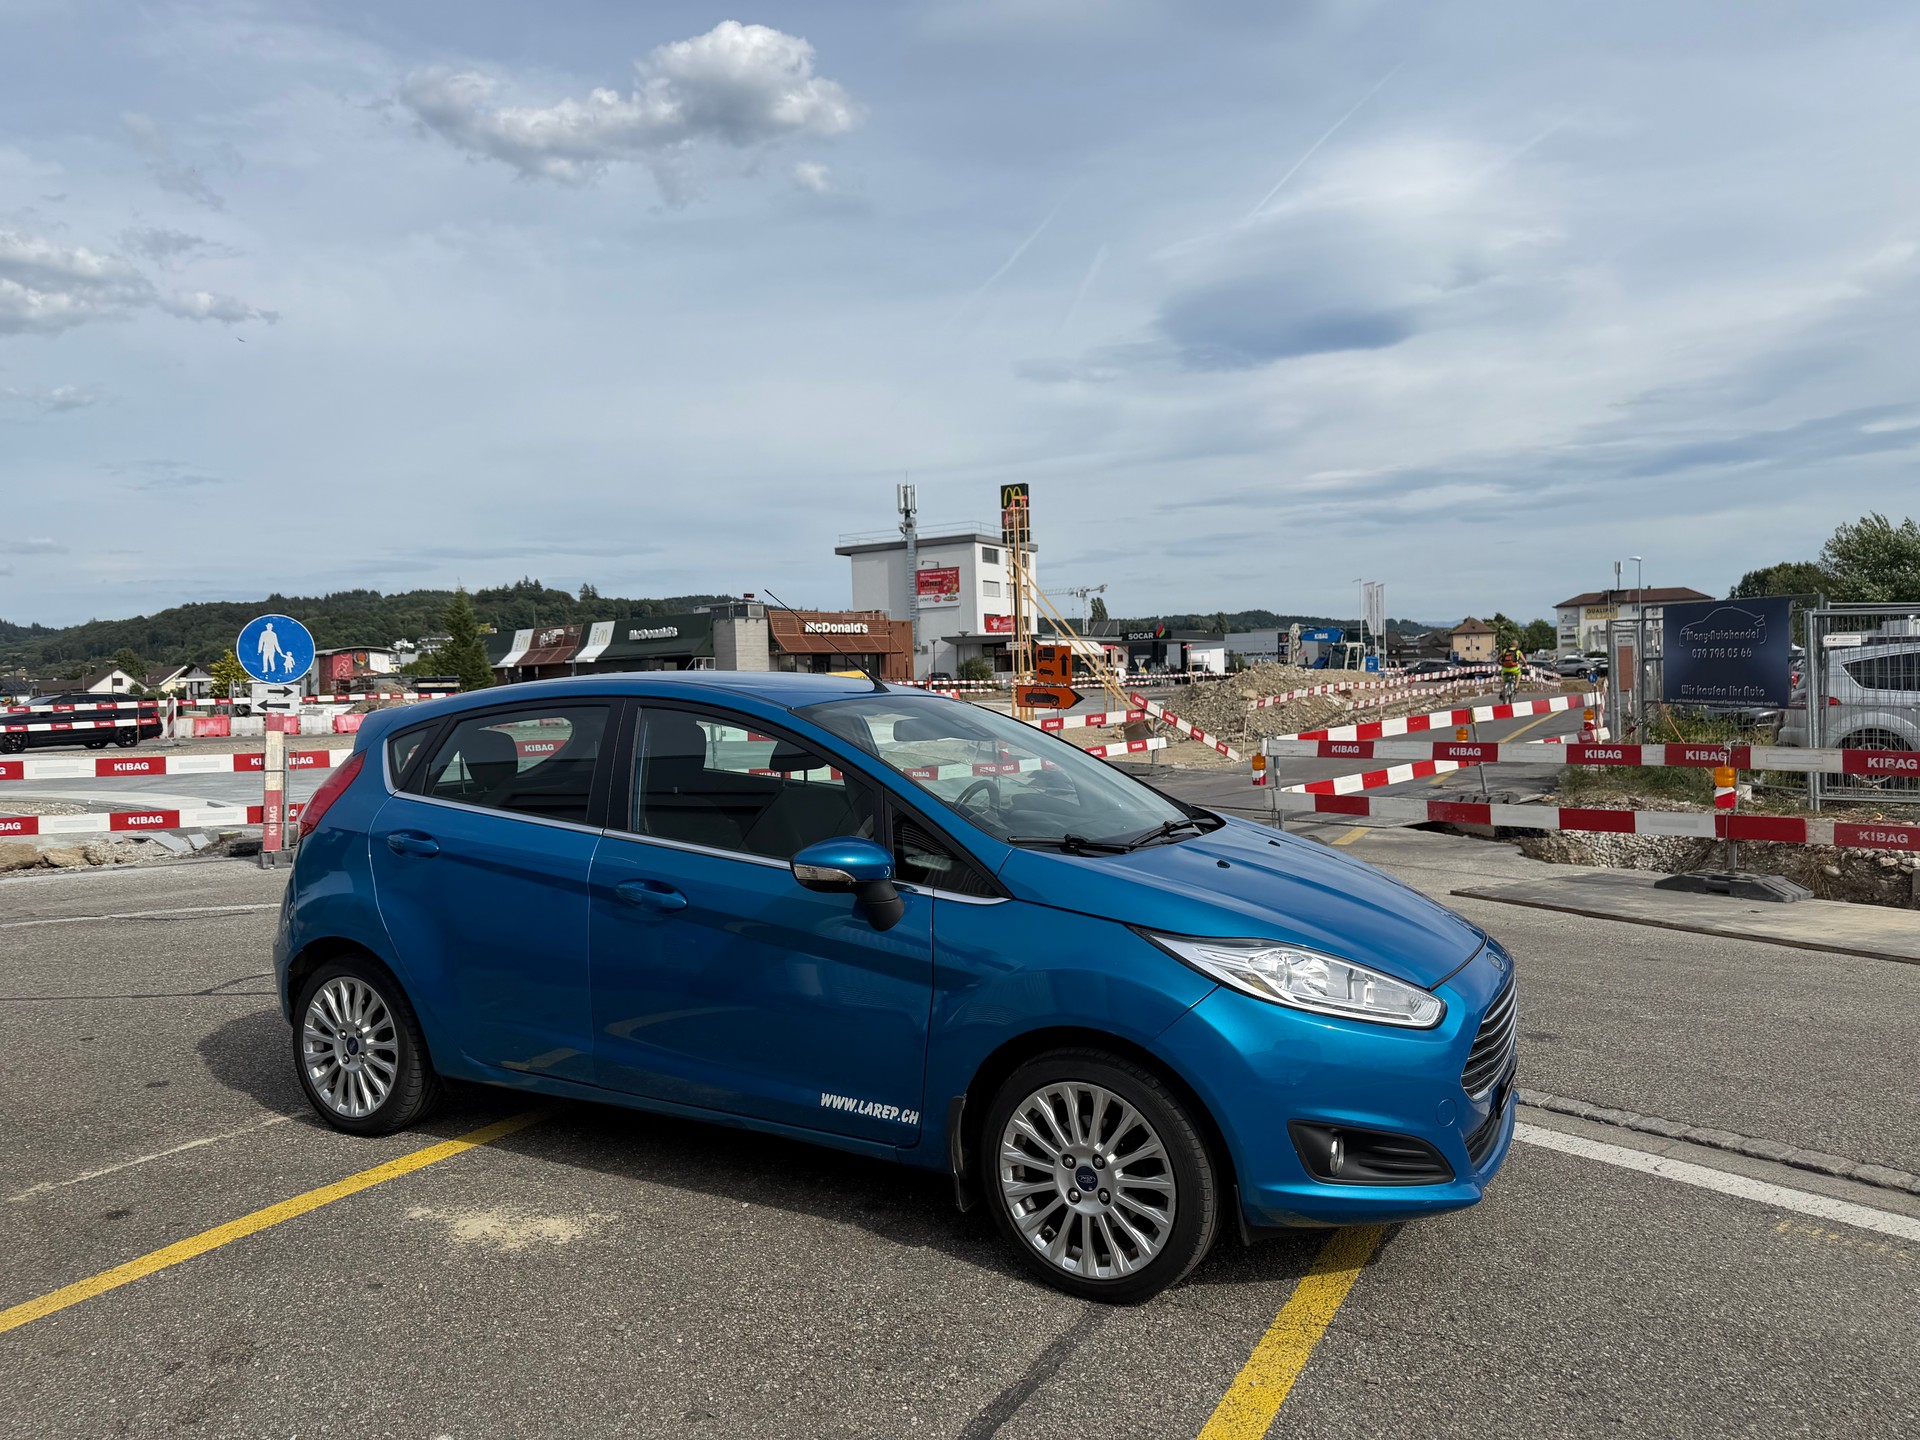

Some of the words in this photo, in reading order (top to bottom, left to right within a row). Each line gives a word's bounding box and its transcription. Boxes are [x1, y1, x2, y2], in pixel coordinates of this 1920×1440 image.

[804, 621, 869, 633] McDonald's
[1128, 631, 1154, 640] SOCAR
[1692, 648, 1707, 658] 079
[1709, 648, 1725, 658] 798
[1727, 648, 1738, 658] 05
[1681, 684, 1695, 695] Wir
[1697, 685, 1727, 696] kaufen
[1729, 685, 1741, 696] Ihr
[1743, 685, 1765, 697] Auto
[525, 743, 554, 752] KIBAG
[1331, 744, 1360, 754] KIBAG
[1448, 746, 1482, 757] KIBAG
[1584, 749, 1622, 759] KIBAG
[1685, 750, 1728, 761] KIBAG
[288, 756, 314, 765] IBAG
[1867, 757, 1918, 770] KIBAG
[114, 762, 149, 771] KIBAG
[128, 815, 163, 825] KIBAG
[269, 805, 278, 836] KIBAG
[1858, 830, 1909, 844] KIBAG
[820, 1092, 919, 1125] WWW.LAREP.CH
